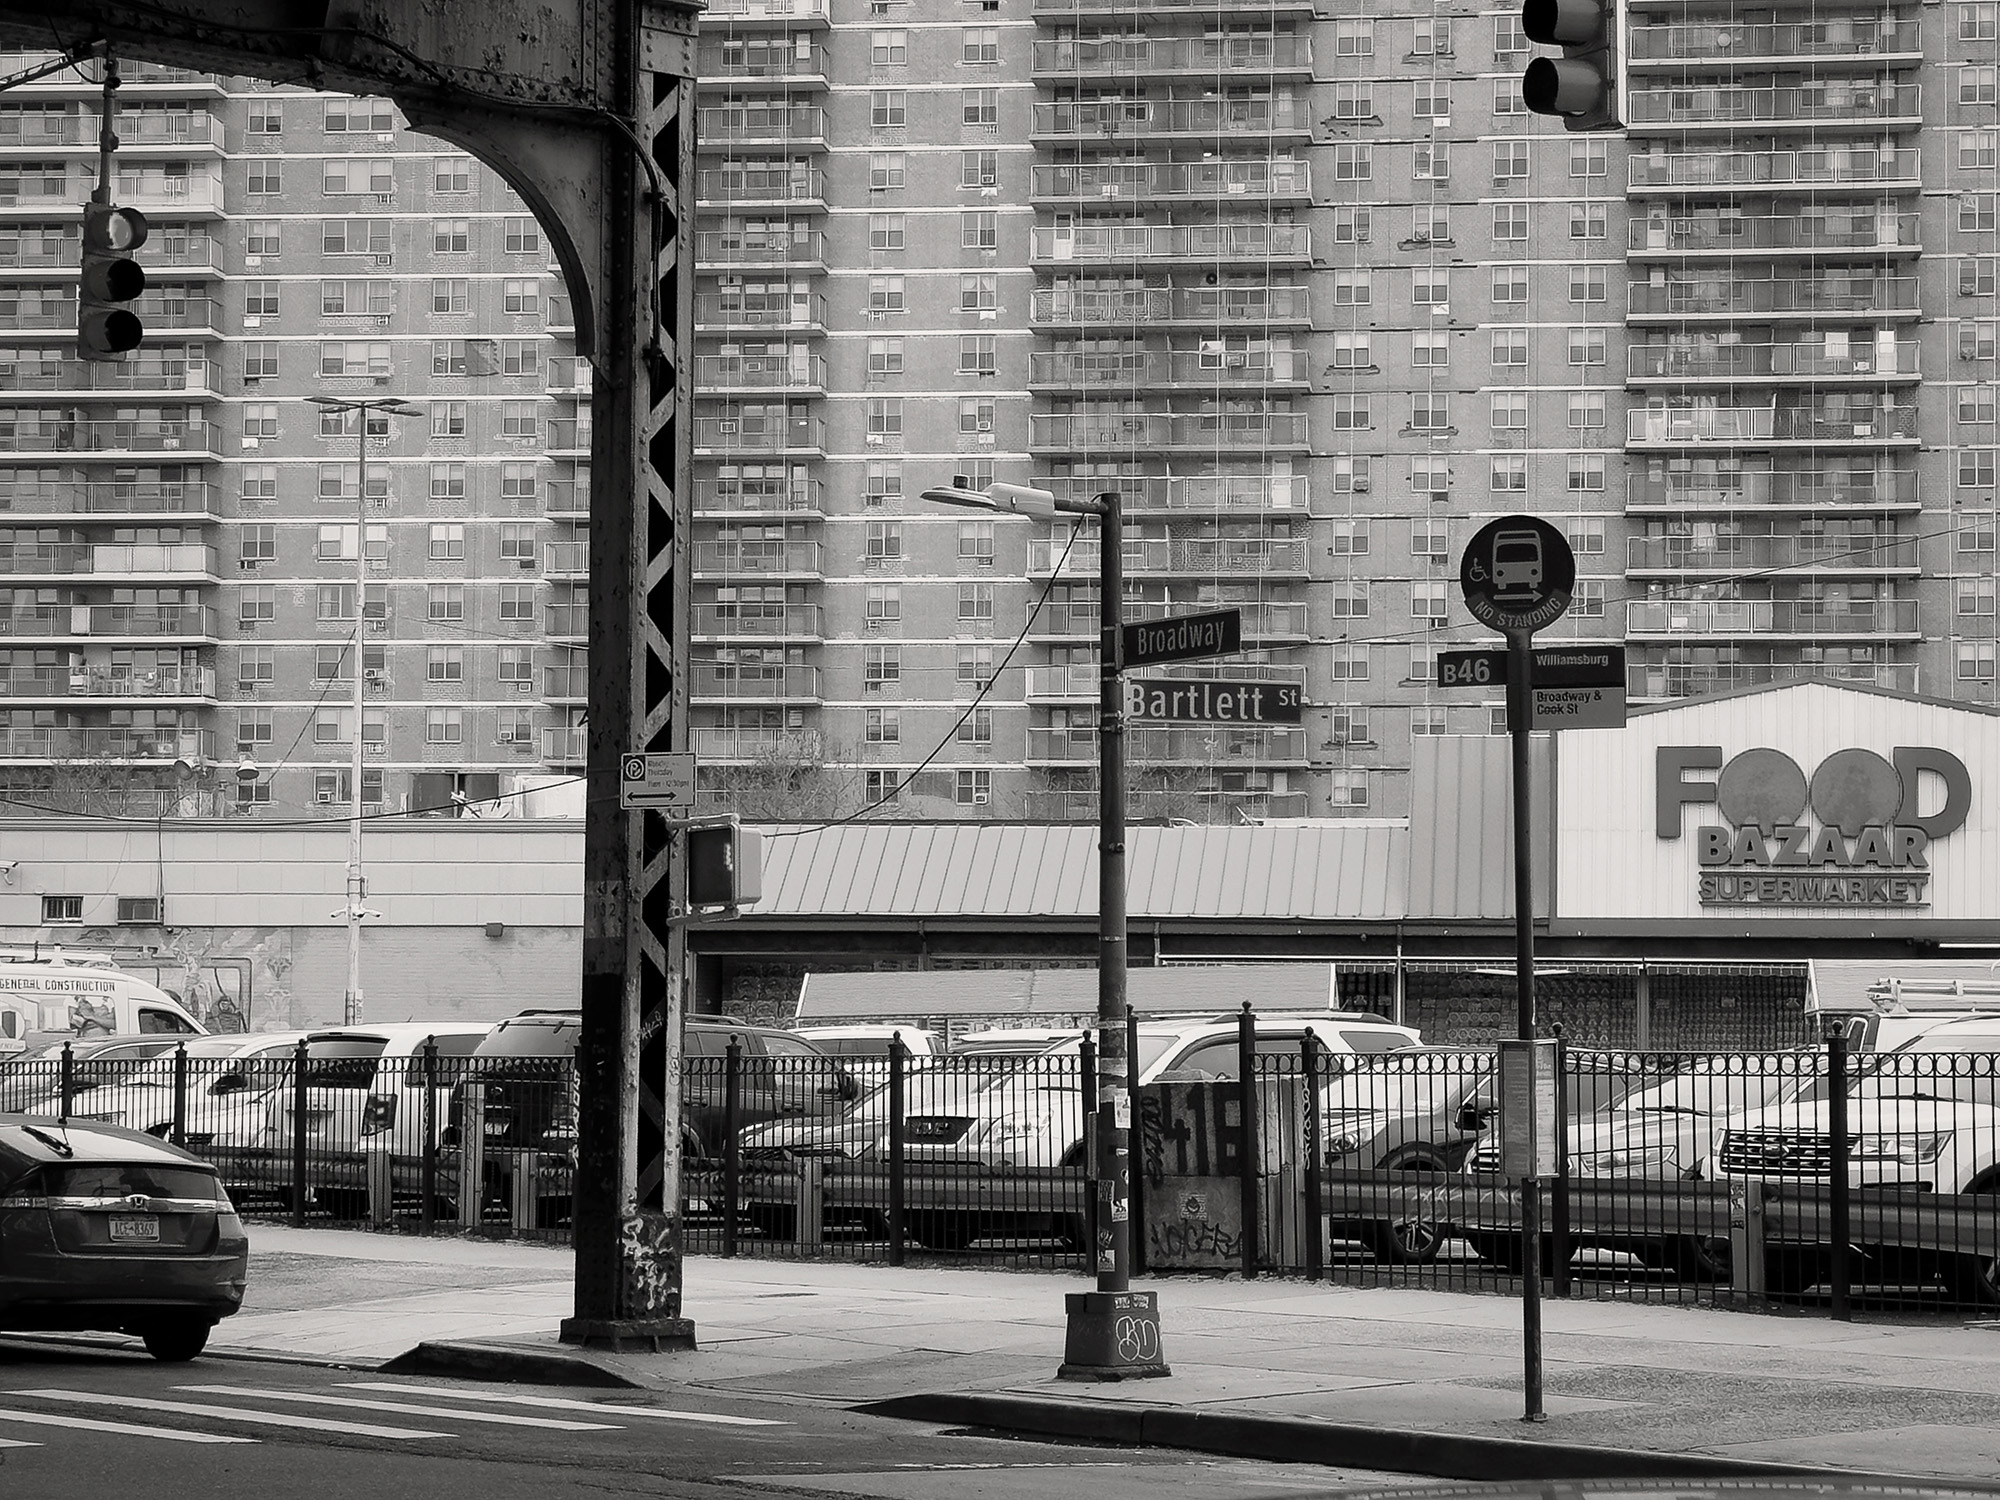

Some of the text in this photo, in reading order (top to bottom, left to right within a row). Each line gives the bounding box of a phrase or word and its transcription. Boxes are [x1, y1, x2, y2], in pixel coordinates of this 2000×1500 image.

[1473, 597, 1562, 628] NO STANDING
[1138, 620, 1225, 655] Broadway
[1443, 658, 1490, 683] B46
[1535, 654, 1609, 666] Williamsburg
[1129, 684, 1297, 720] Bartlett St
[1536, 691, 1602, 703] Broadway &
[1536, 703, 1579, 715] Cook St
[1656, 746, 1972, 839] FOOD
[1698, 824, 1928, 867] BAZAAR
[1700, 876, 1928, 901] SUPERMARKET
[45, 980, 115, 992] CONSTRUCTION
